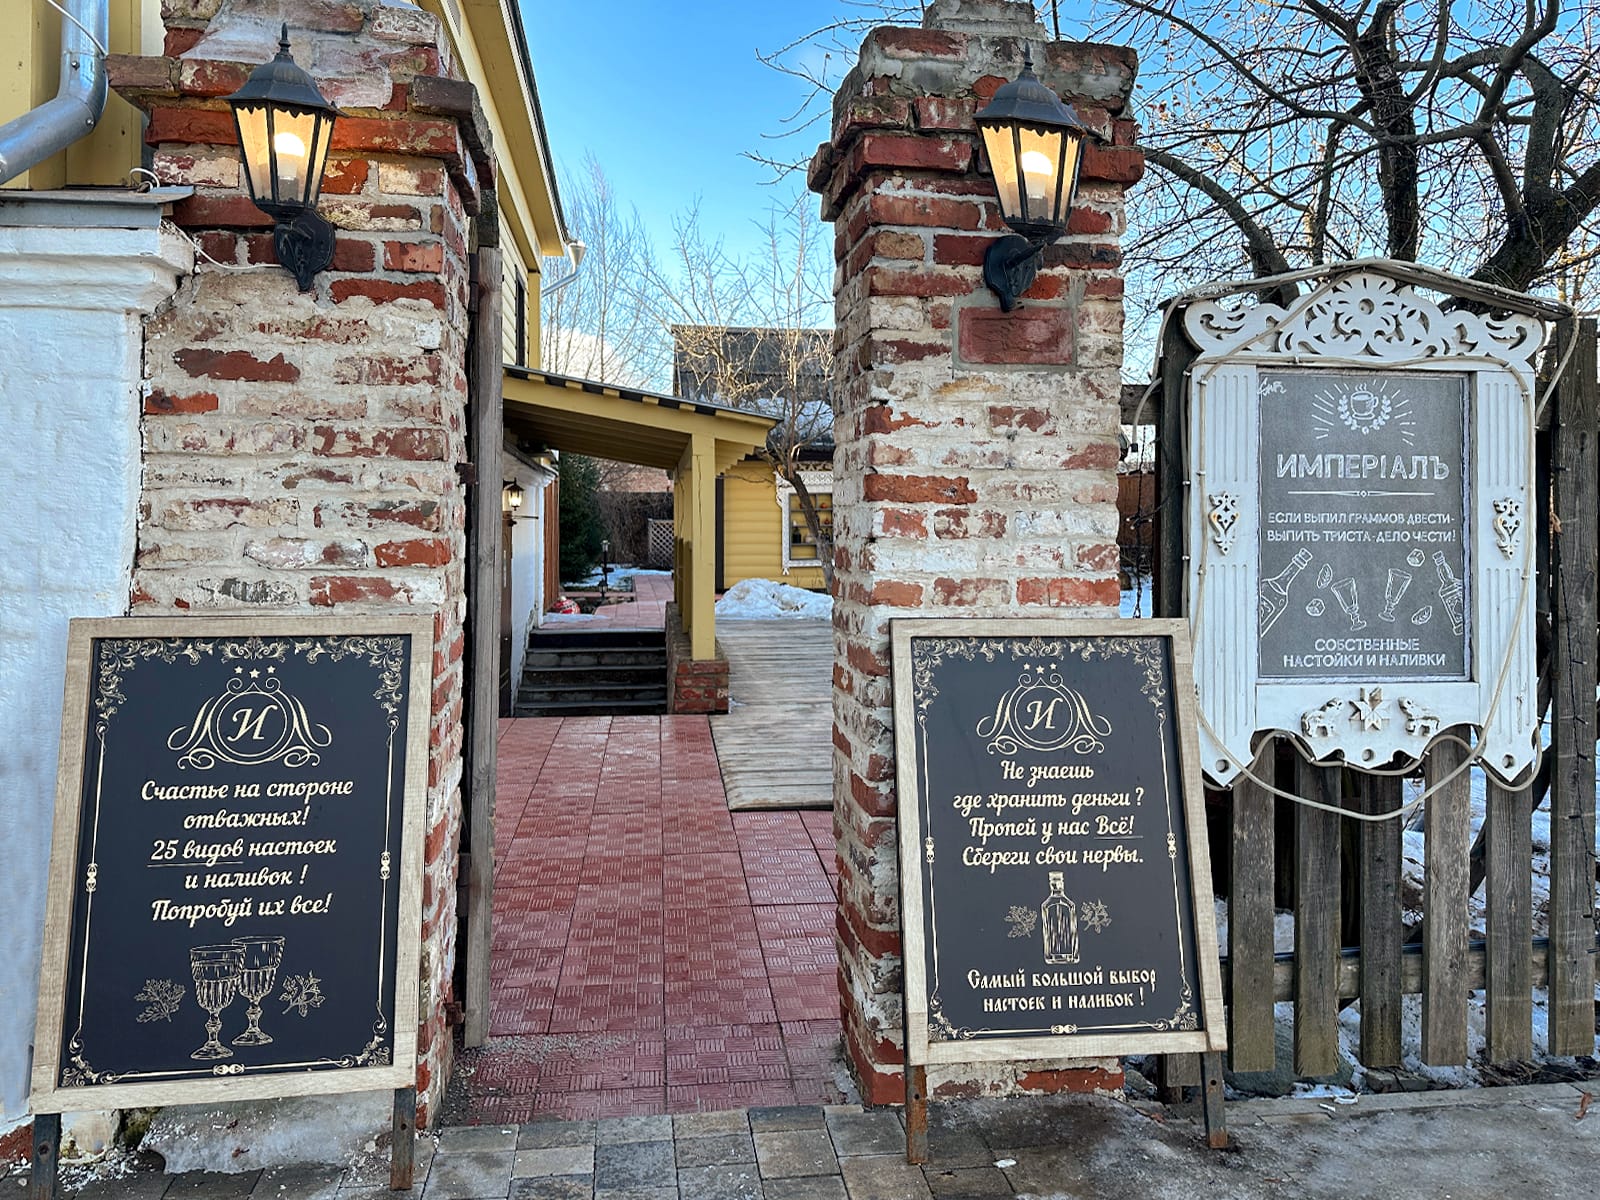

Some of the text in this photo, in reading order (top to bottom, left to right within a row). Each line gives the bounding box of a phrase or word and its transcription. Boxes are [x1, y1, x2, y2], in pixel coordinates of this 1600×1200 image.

[1276, 453, 1450, 480] ИМПЕРІАЛЪ
[1268, 512, 1301, 524] ЕСЛИ
[1303, 512, 1347, 524] ВЫПИЛ
[1348, 512, 1404, 524] ГРАММОВ
[1267, 530, 1321, 542] ВЫПИТЬ
[1412, 529, 1456, 542] ЧЕСТИ!
[1314, 638, 1420, 651] СОБСТВЕННЫЕ
[1283, 653, 1446, 668] НАСТОЙКИ И НАЛИВКИ
[1000, 760, 1094, 788] Не знаешь
[141, 780, 354, 804] Счастье на стороне
[952, 794, 983, 817] где
[986, 792, 1067, 816] хранить
[1071, 791, 1131, 815] деньги
[183, 805, 311, 829] отважных!
[968, 815, 1135, 845] Пропей у нас Всё!
[150, 838, 337, 867] 25 видов настоек
[962, 844, 1144, 874] Сбереги свои нервы.
[184, 873, 198, 889] и
[203, 867, 293, 889] наливок
[151, 892, 333, 928] Попробуй их все!
[967, 968, 1026, 989] Самый
